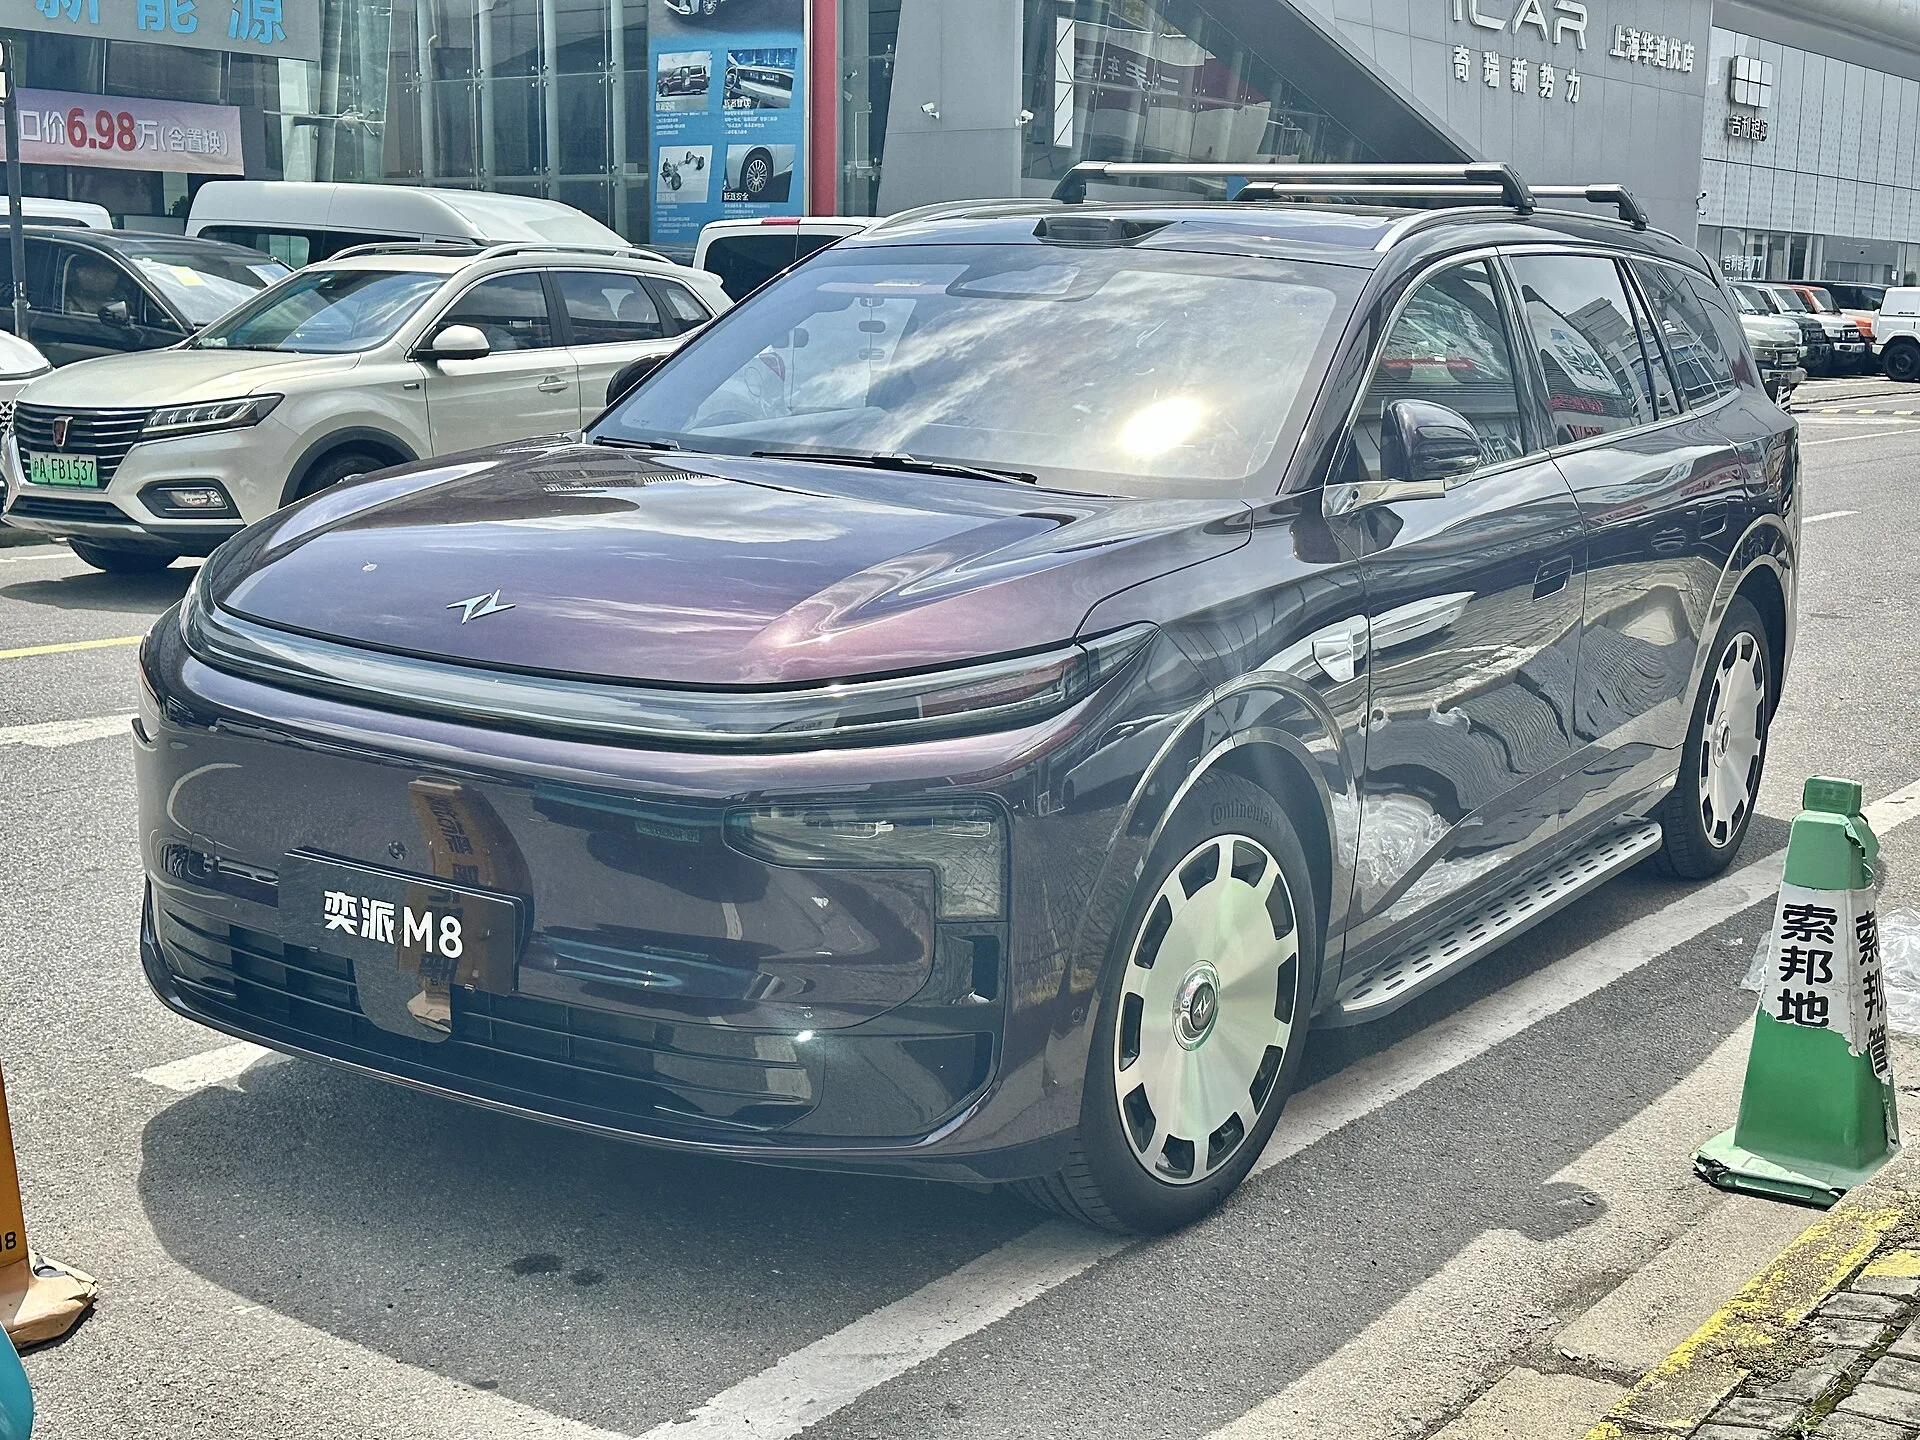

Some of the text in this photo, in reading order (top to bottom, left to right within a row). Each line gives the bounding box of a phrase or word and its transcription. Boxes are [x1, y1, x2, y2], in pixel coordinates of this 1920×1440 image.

[1453, 45, 1581, 103] 奇瑞新势力
[0, 107, 229, 156] 口价6.98万(含置换)
[51, 459, 94, 482] FB1537
[1211, 799, 1273, 827] Continental
[0, 1231, 17, 1251] 8
